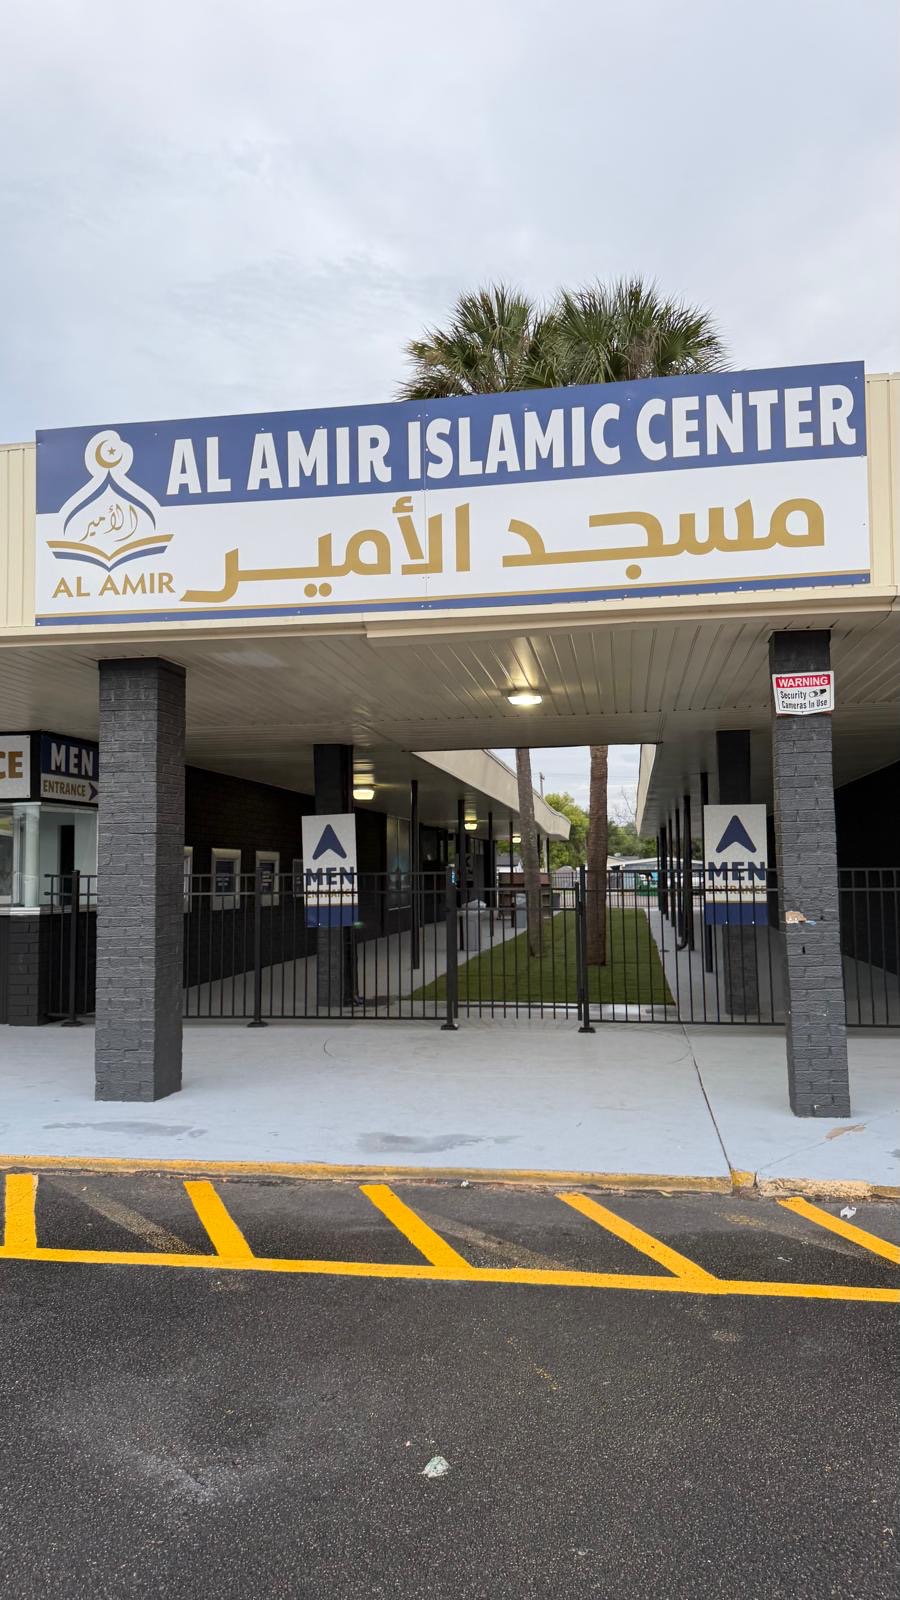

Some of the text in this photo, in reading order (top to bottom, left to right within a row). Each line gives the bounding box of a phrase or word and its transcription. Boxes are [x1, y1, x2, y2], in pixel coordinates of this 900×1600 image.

[166, 384, 857, 496] AL AMIR ISLAMIC CENTER
[179, 496, 825, 604] مسجد الأمير
[52, 572, 176, 598] AL AMIR
[778, 676, 828, 687] WARNING
[780, 690, 807, 700] Security
[781, 699, 828, 710] Cameras In Use
[50, 742, 94, 777] MEN
[43, 780, 86, 797] ENTRANCE
[306, 866, 355, 886] MEN
[708, 861, 766, 881] MEN
